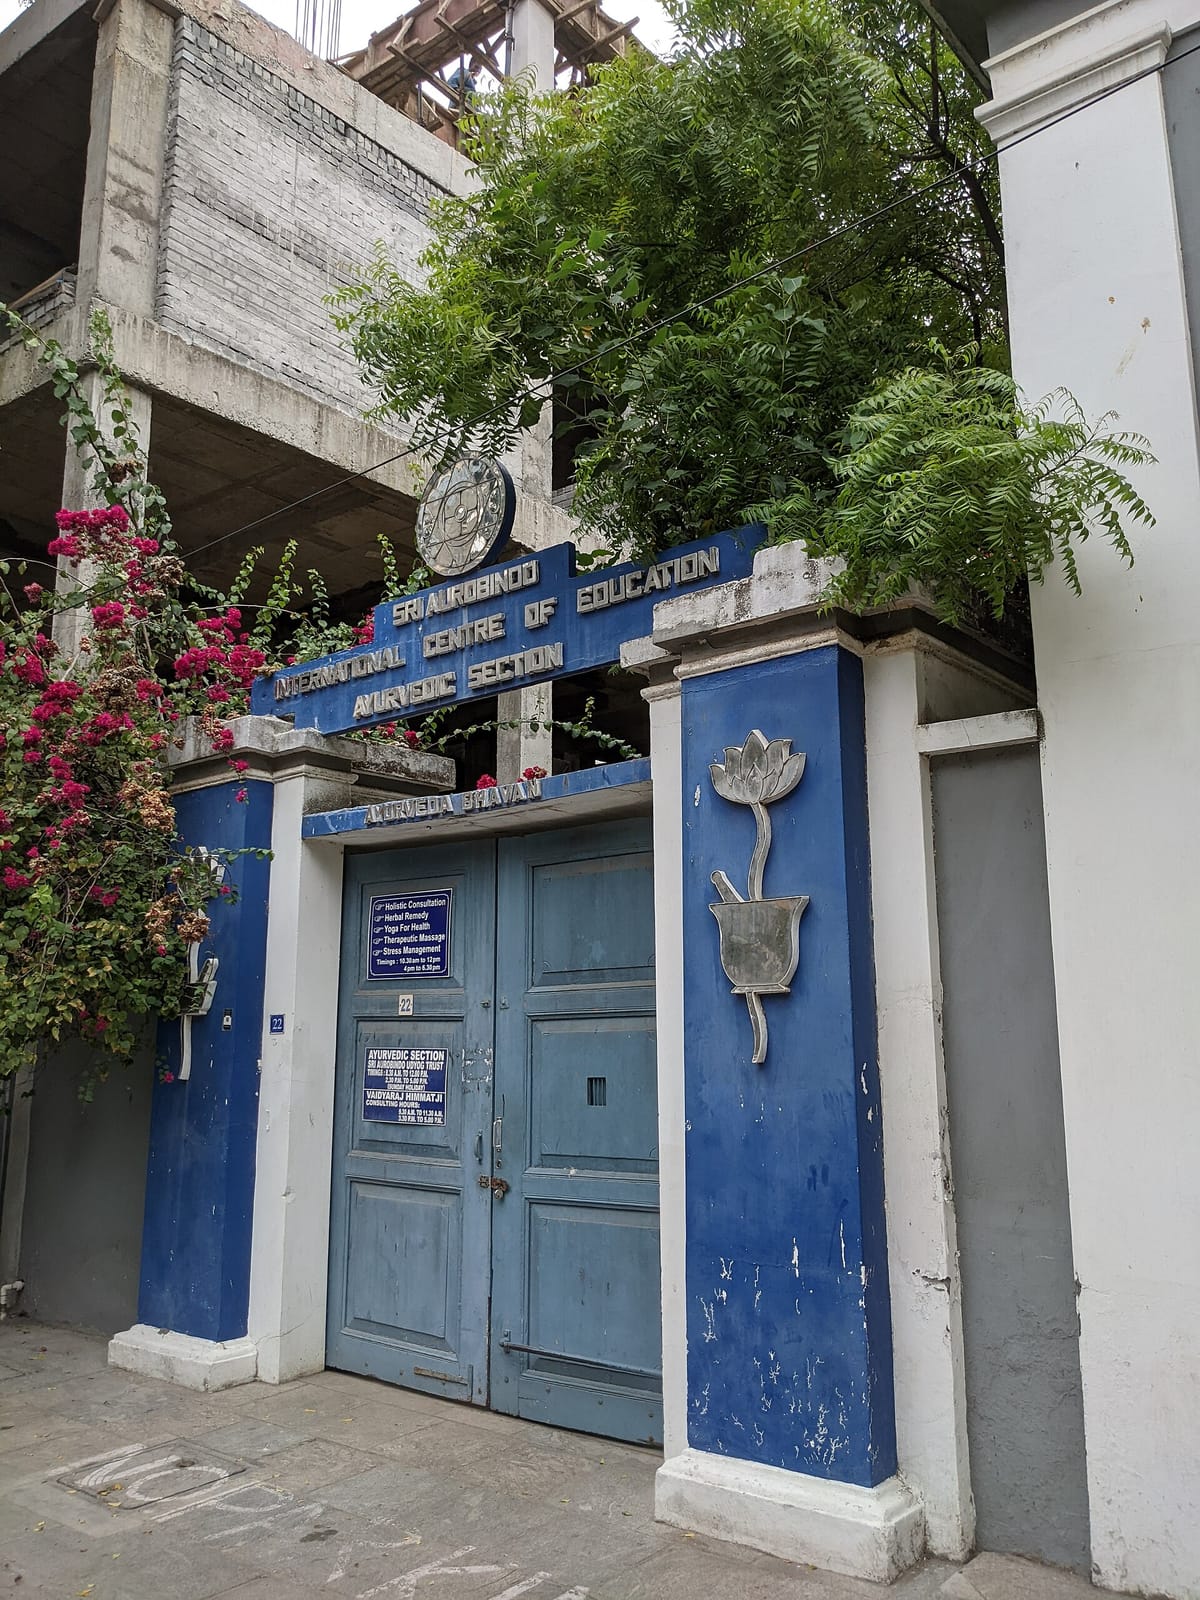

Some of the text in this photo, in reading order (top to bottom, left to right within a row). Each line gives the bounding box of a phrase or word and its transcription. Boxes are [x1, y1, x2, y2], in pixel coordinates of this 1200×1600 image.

[393, 560, 540, 626] SRI AUROBINDO
[274, 546, 720, 700] INTERNATIONAL CENTRE OF EDUCATION
[353, 642, 564, 720] AYURVEDIC SECTION
[364, 779, 542, 825] AYURVEDA BHAVAN
[385, 899, 446, 910] Holistic Consultation
[385, 911, 428, 922] Herbal Remedy
[384, 926, 398, 934] Yoga
[411, 922, 430, 930] Health
[384, 934, 445, 945] Therapeutic Massage
[384, 945, 440, 956] Stress Management
[400, 998, 411, 1012] 22
[272, 1018, 282, 1030] 22
[368, 1050, 444, 1060] AYURVEDIC SECTION
[368, 1060, 444, 1070] SRI AUROBINDO UDYOG TRUST
[366, 1091, 442, 1102] VAIDYARAJ HIMMATJI
